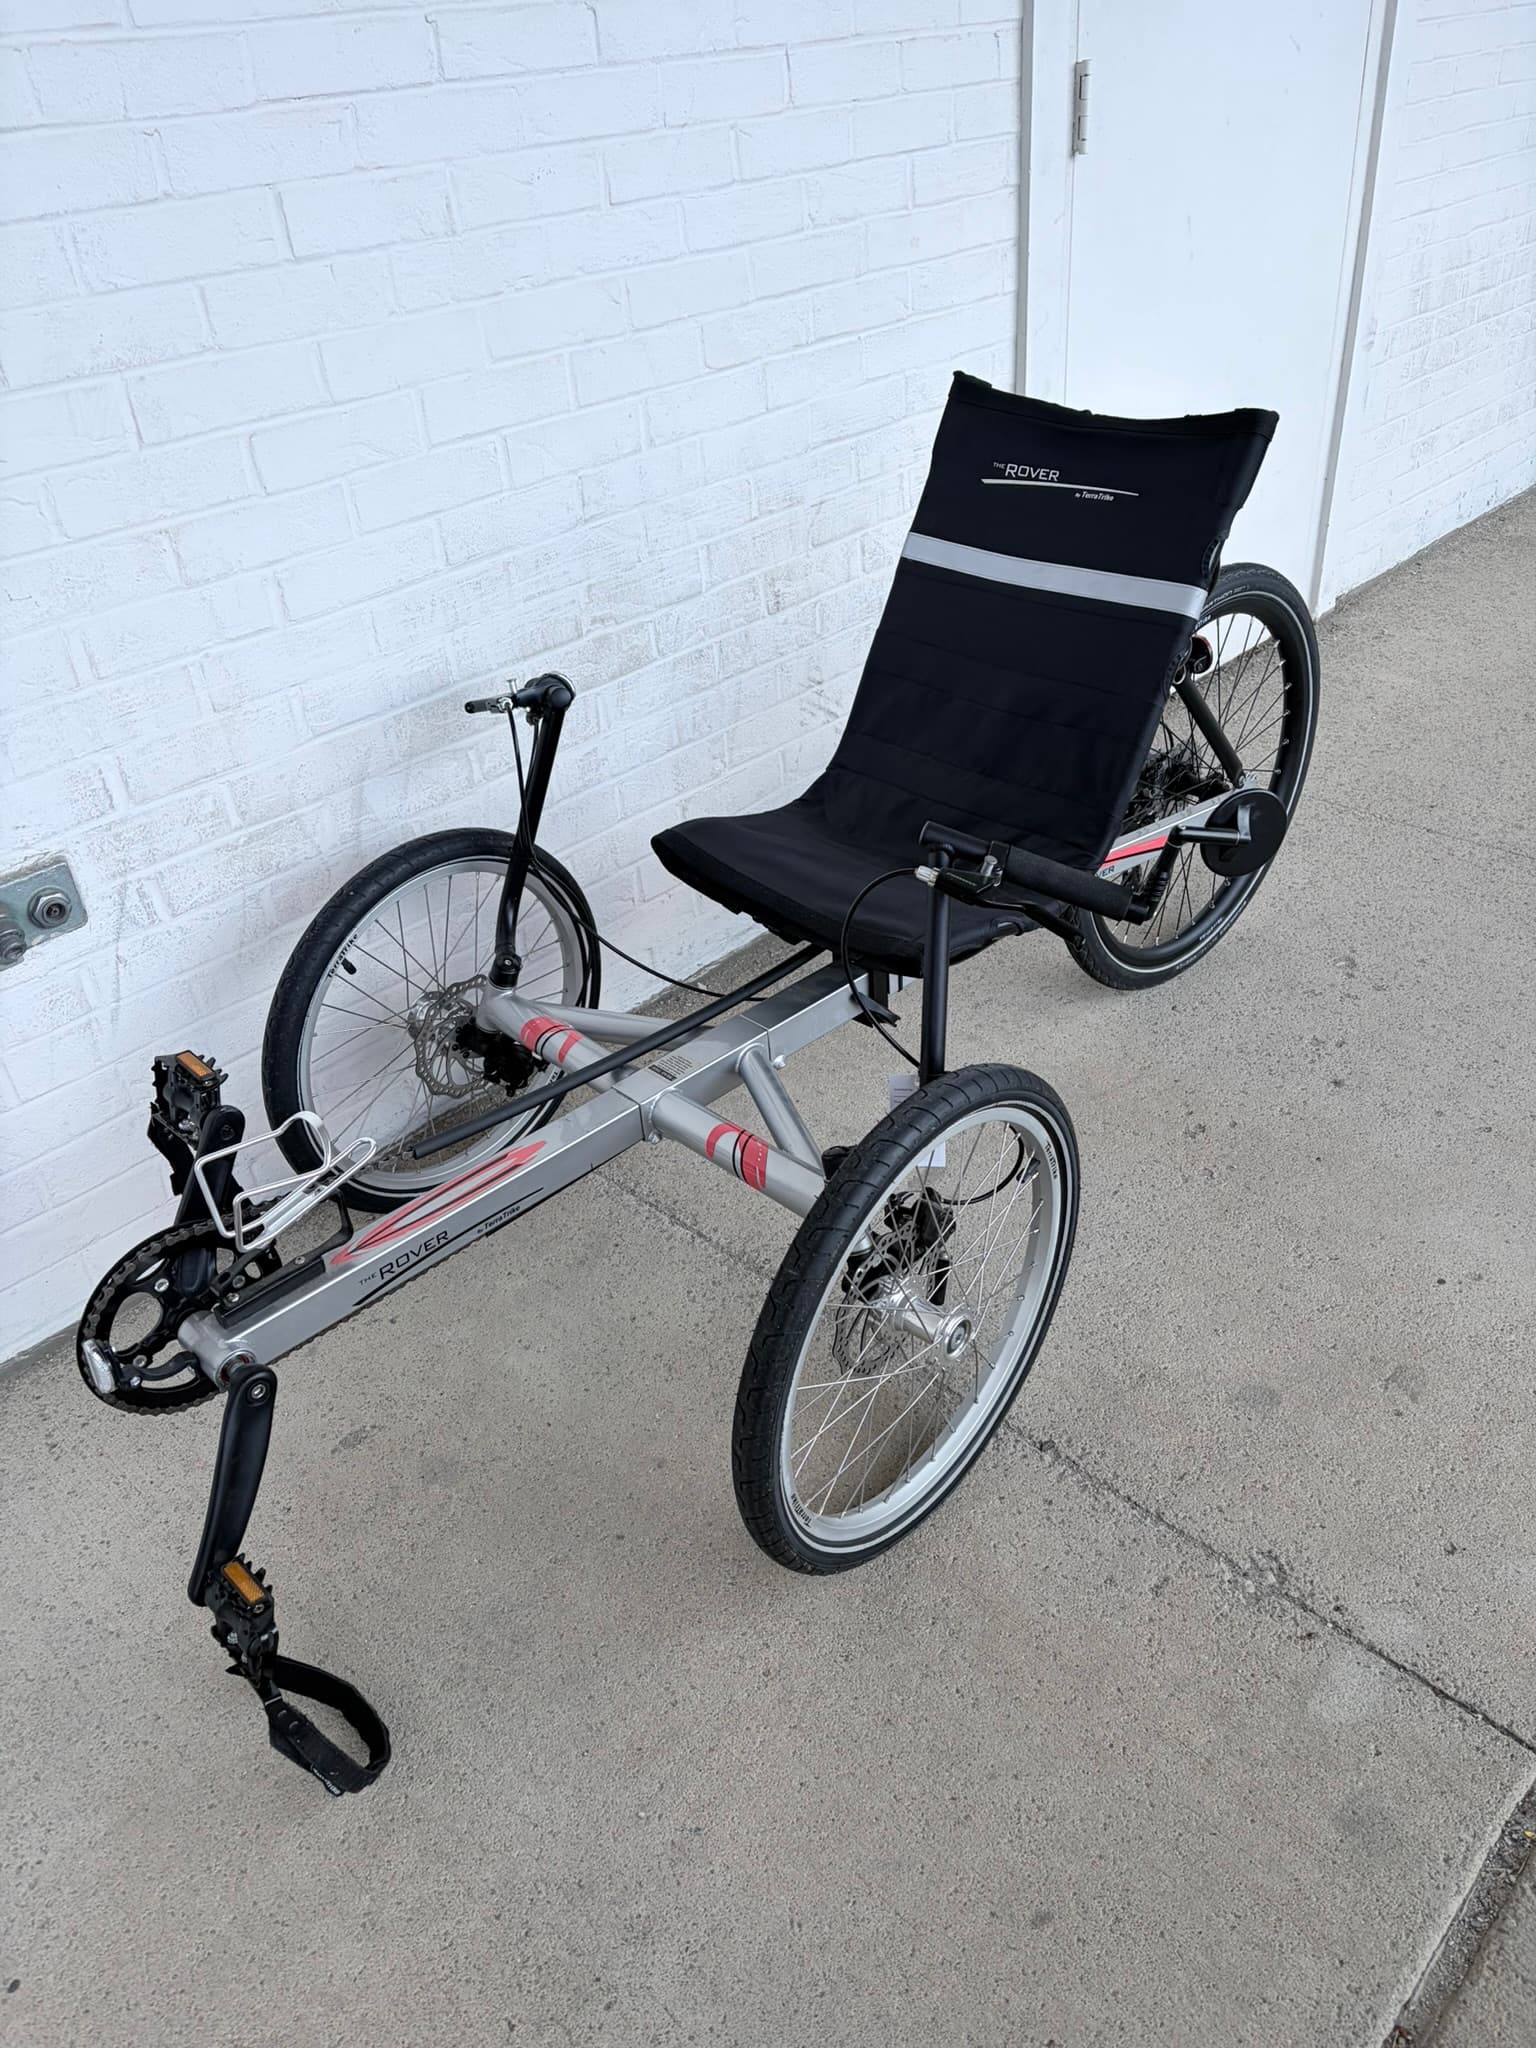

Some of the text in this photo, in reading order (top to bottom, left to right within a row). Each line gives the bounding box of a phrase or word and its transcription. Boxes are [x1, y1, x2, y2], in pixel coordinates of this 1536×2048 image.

[1005, 463, 1059, 481] ROVER
[1096, 865, 1115, 877] VER
[328, 933, 358, 978] TerraTrike
[359, 1230, 449, 1286] THE ROVER
